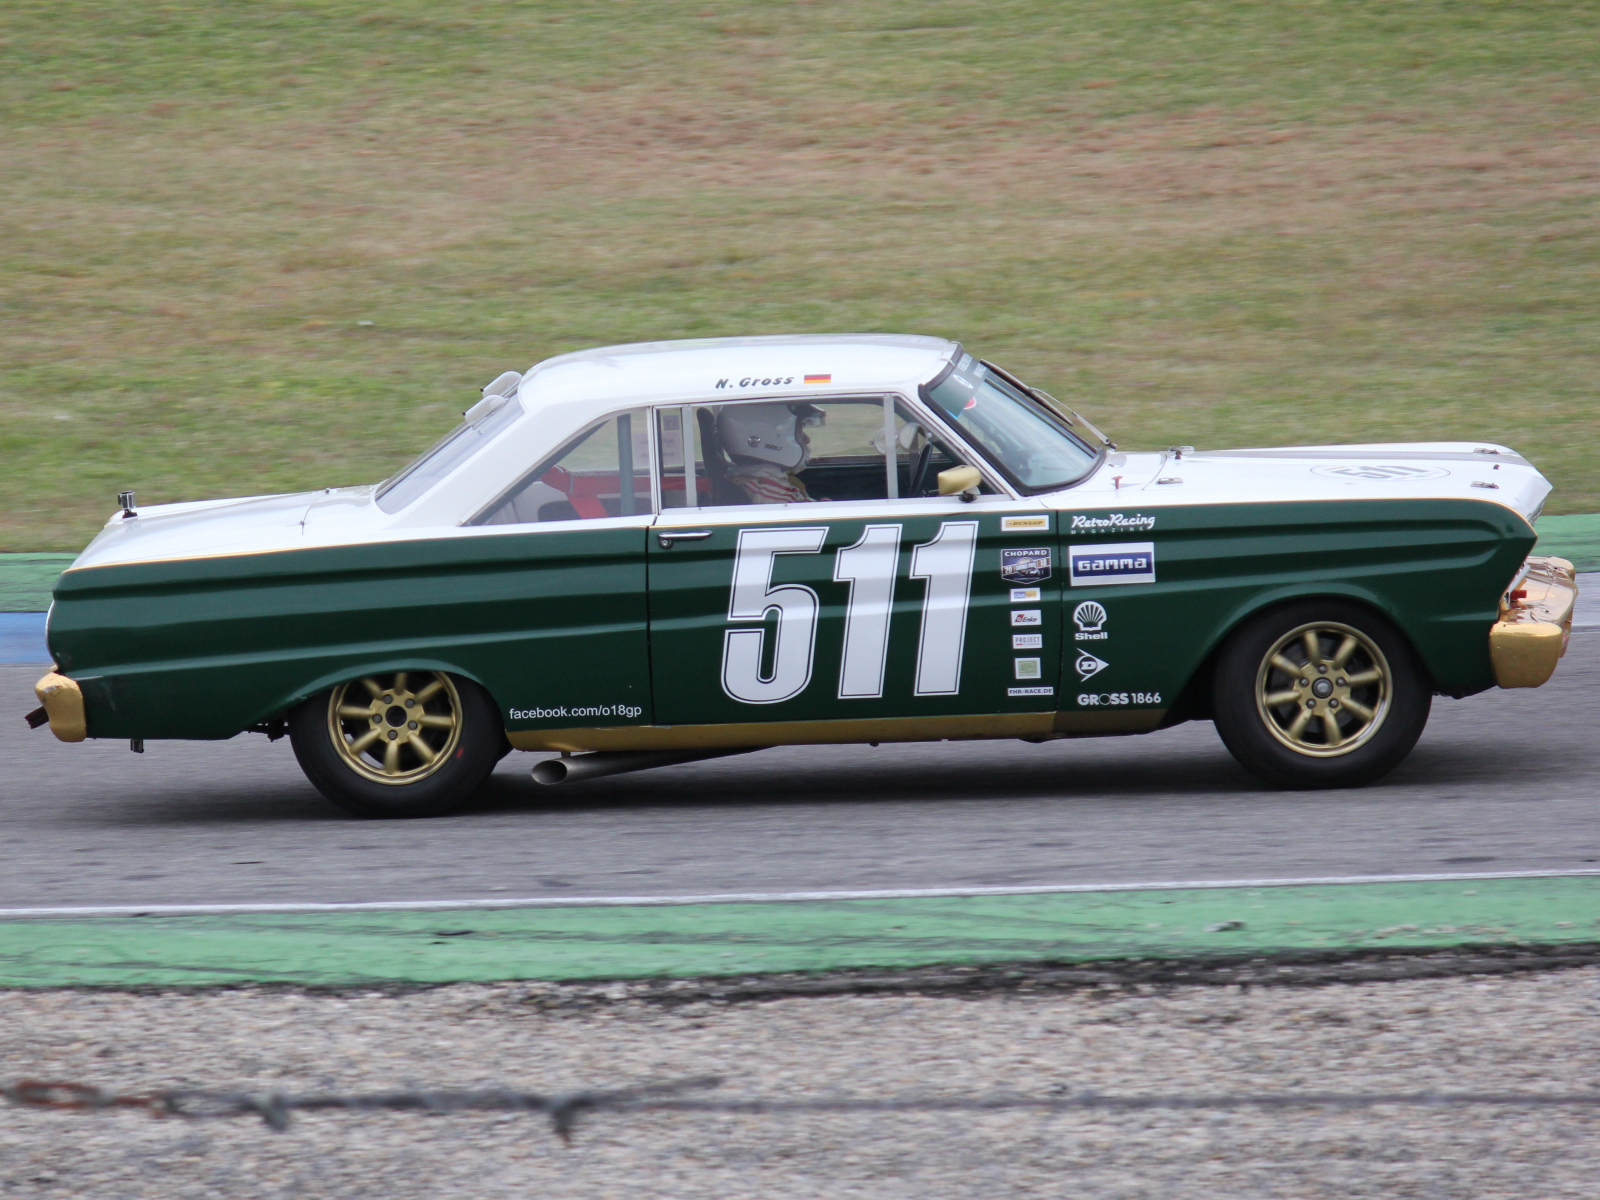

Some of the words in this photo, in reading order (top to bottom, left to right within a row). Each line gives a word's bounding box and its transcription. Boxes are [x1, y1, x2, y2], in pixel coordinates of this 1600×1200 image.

[715, 378, 733, 389] N.
[739, 377, 794, 388] Gross
[1071, 513, 1156, 529] RetroRacing
[1070, 526, 1144, 535] MAGAZINE
[1004, 549, 1047, 557] CHOPARD
[721, 520, 979, 705] 511
[1074, 631, 1109, 640] Shell
[1077, 692, 1130, 706] GROSS
[1131, 692, 1162, 704] 1866
[509, 704, 642, 719] facebook.com/o18gp
